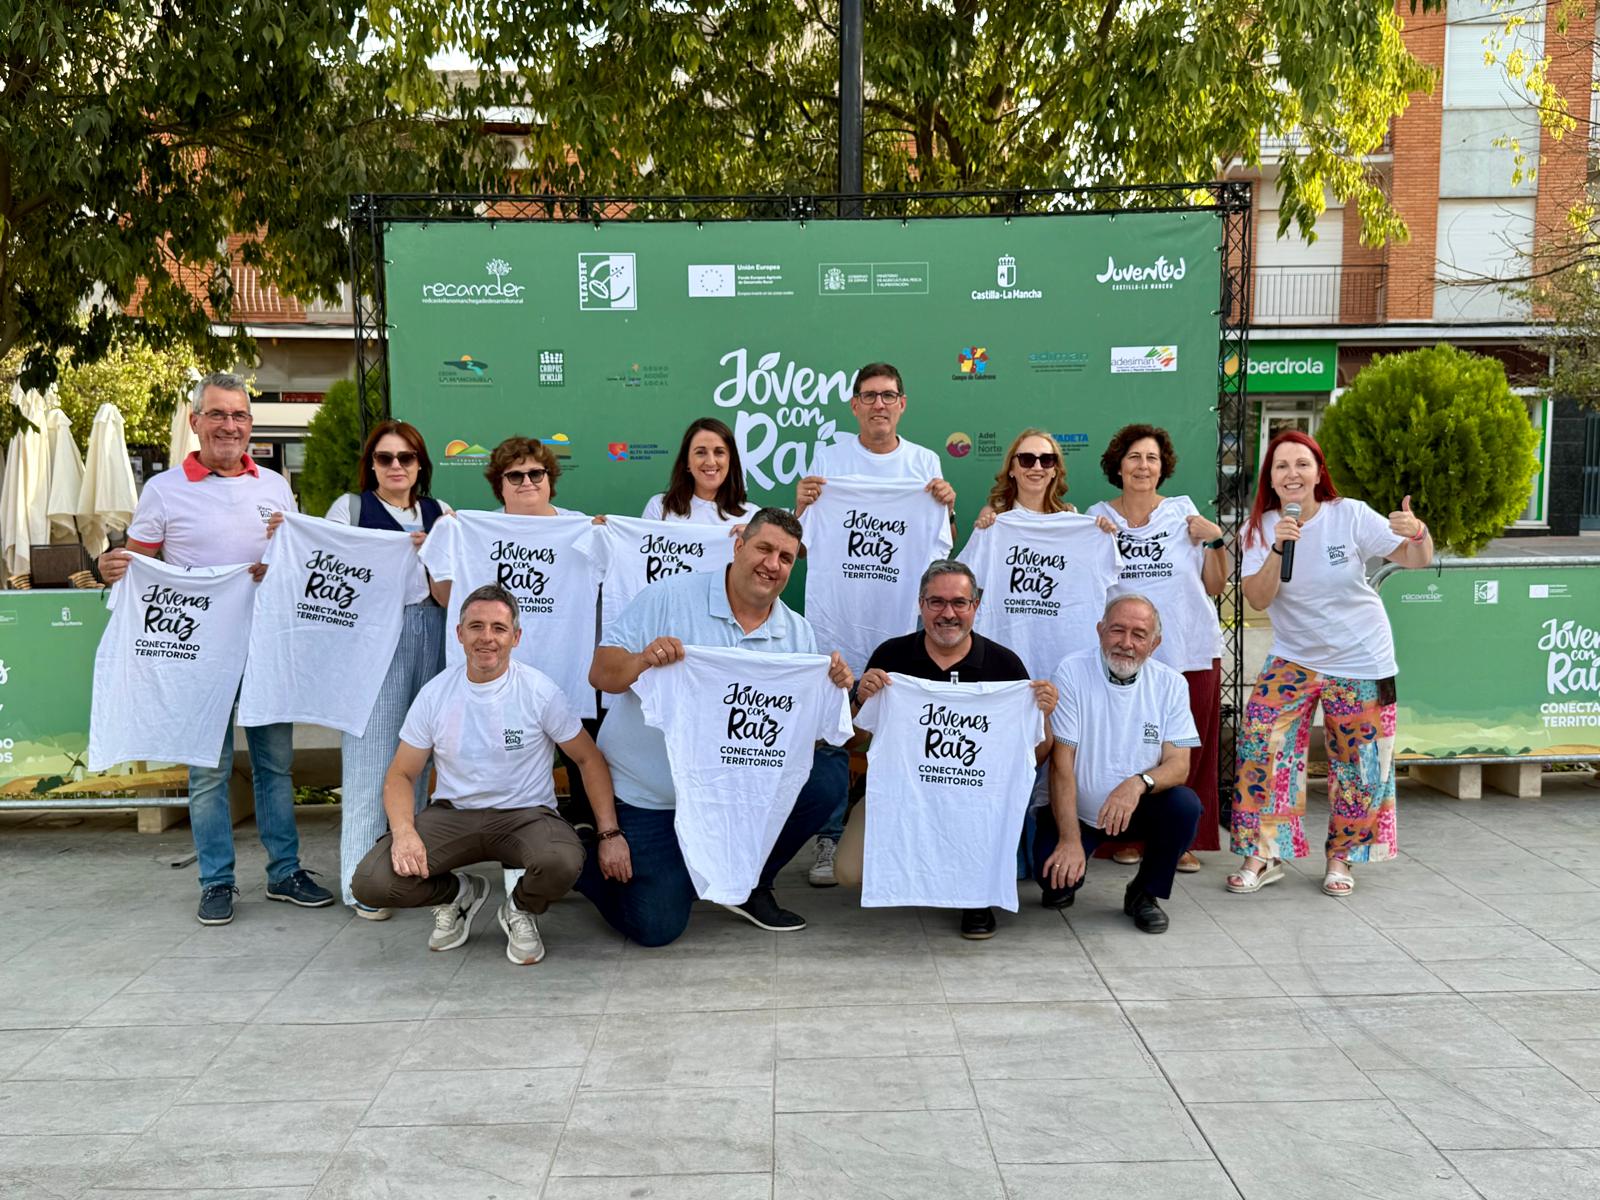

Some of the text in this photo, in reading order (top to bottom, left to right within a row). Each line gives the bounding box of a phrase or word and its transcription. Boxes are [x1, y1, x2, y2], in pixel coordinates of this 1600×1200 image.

[1096, 255, 1186, 283] Juventud
[580, 262, 588, 302] LEADER
[1013, 289, 1042, 299] Mancha
[1111, 357, 1154, 366] adesiman
[713, 348, 860, 408] Jóven
[776, 407, 824, 428] con
[1053, 433, 1088, 442] ADETA
[734, 410, 850, 491] Raí
[843, 510, 908, 536] Jóvenes
[490, 540, 557, 564] Jóvenes
[640, 534, 706, 557] Jóvenes
[848, 530, 898, 564] Raíz
[306, 550, 374, 583] Jóvenes
[842, 563, 899, 575] CONECTANDO
[1006, 545, 1068, 570] Jóvenes
[1123, 562, 1173, 571] NECTANDO
[498, 562, 550, 596] Raíz
[843, 571, 897, 583] TERRITORIOS
[1010, 566, 1059, 599] Raíz
[1118, 570, 1172, 580] ERRITORIOS
[142, 584, 212, 611] Jóvenes
[305, 571, 360, 609] Raíz
[297, 602, 358, 620] CONECTANDO
[1004, 598, 1060, 608] CONECTANDO
[1005, 607, 1058, 616] TERRITORIOS
[144, 604, 200, 641] Raíz
[297, 611, 356, 628] TERRITORIOS
[135, 639, 200, 651] CONECTANDO
[135, 648, 197, 660] TERRITORIOS
[1571, 649, 1596, 661] con
[1547, 652, 1600, 695] Raí
[723, 683, 796, 712] Jóvenes
[728, 707, 784, 747] Raíz
[920, 703, 991, 733] Jóvenes
[720, 746, 786, 757] CONECTANDO
[925, 727, 982, 767] Raíz
[721, 756, 783, 767] TERRITORIOS
[918, 764, 985, 777] CONECTANDO
[919, 774, 983, 787] TERRITORIOS
